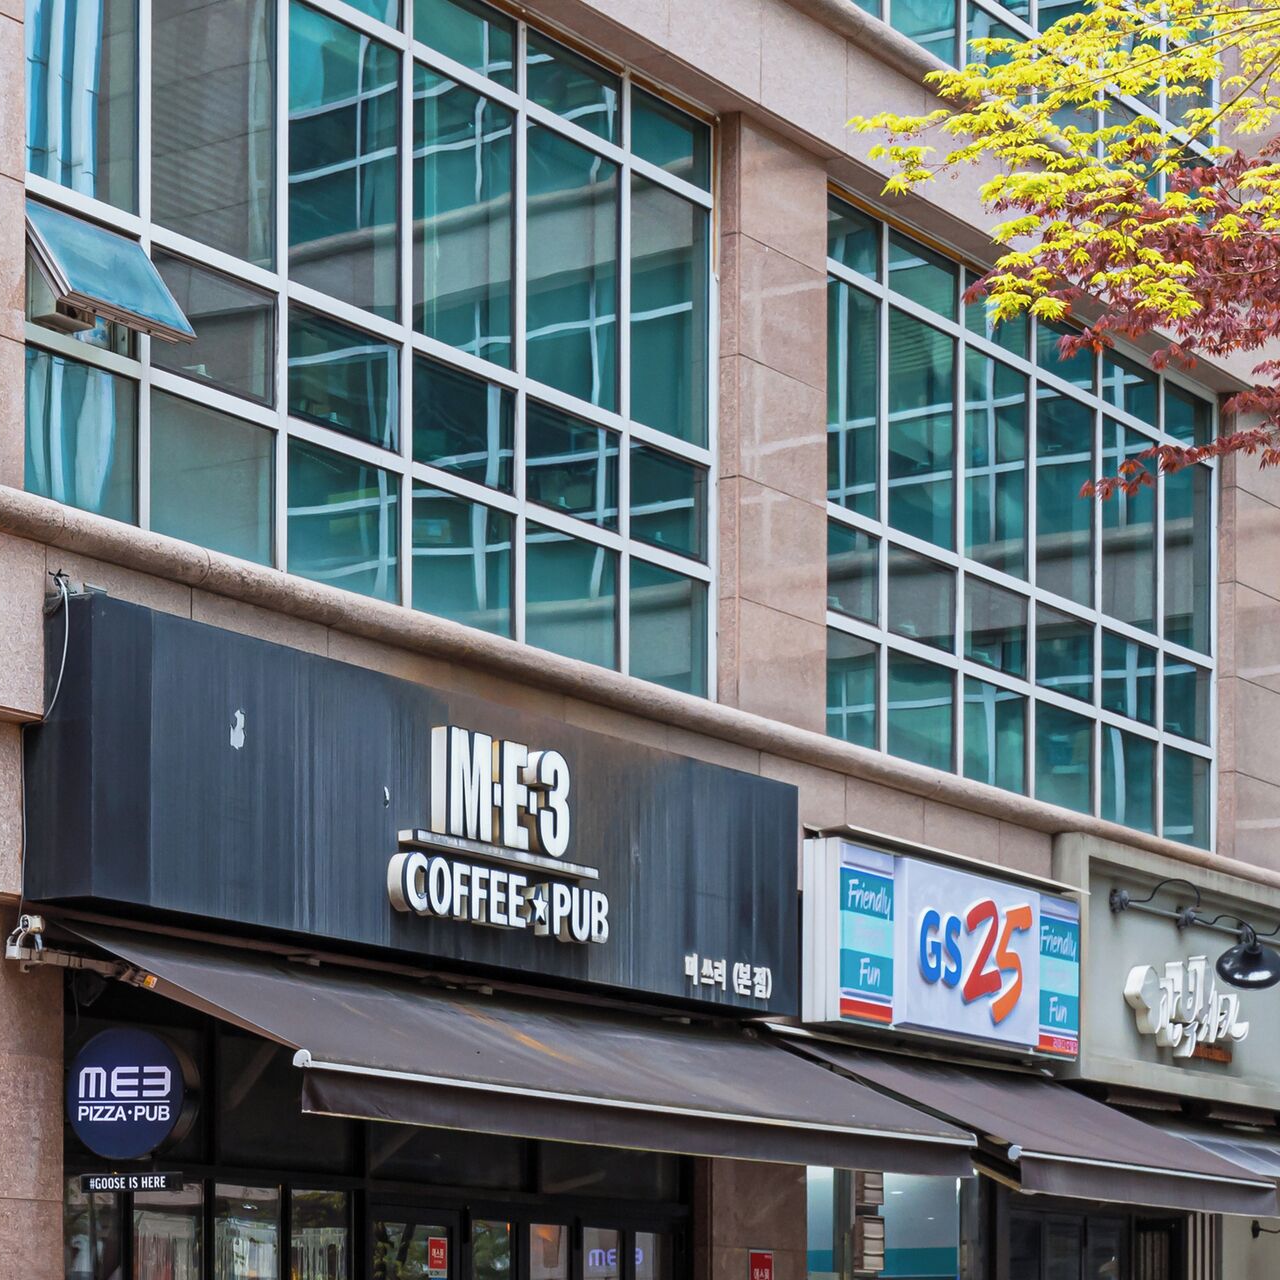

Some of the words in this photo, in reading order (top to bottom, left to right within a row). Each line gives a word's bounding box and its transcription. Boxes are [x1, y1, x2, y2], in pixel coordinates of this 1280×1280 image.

[390, 852, 528, 930] COFFEE
[552, 884, 610, 944] PUB
[847, 879, 892, 920] Friendly
[918, 897, 1033, 1026] GS25
[1040, 925, 1077, 962] Friendly
[684, 952, 727, 991] 미쓰리
[732, 962, 773, 999] (본점)
[859, 957, 881, 987] Fun
[1049, 996, 1068, 1024] Fun
[78, 1065, 172, 1098] ME3
[89, 1177, 126, 1190] #GOOSE
[129, 1177, 138, 1189] IS
[141, 1176, 167, 1188] HERE
